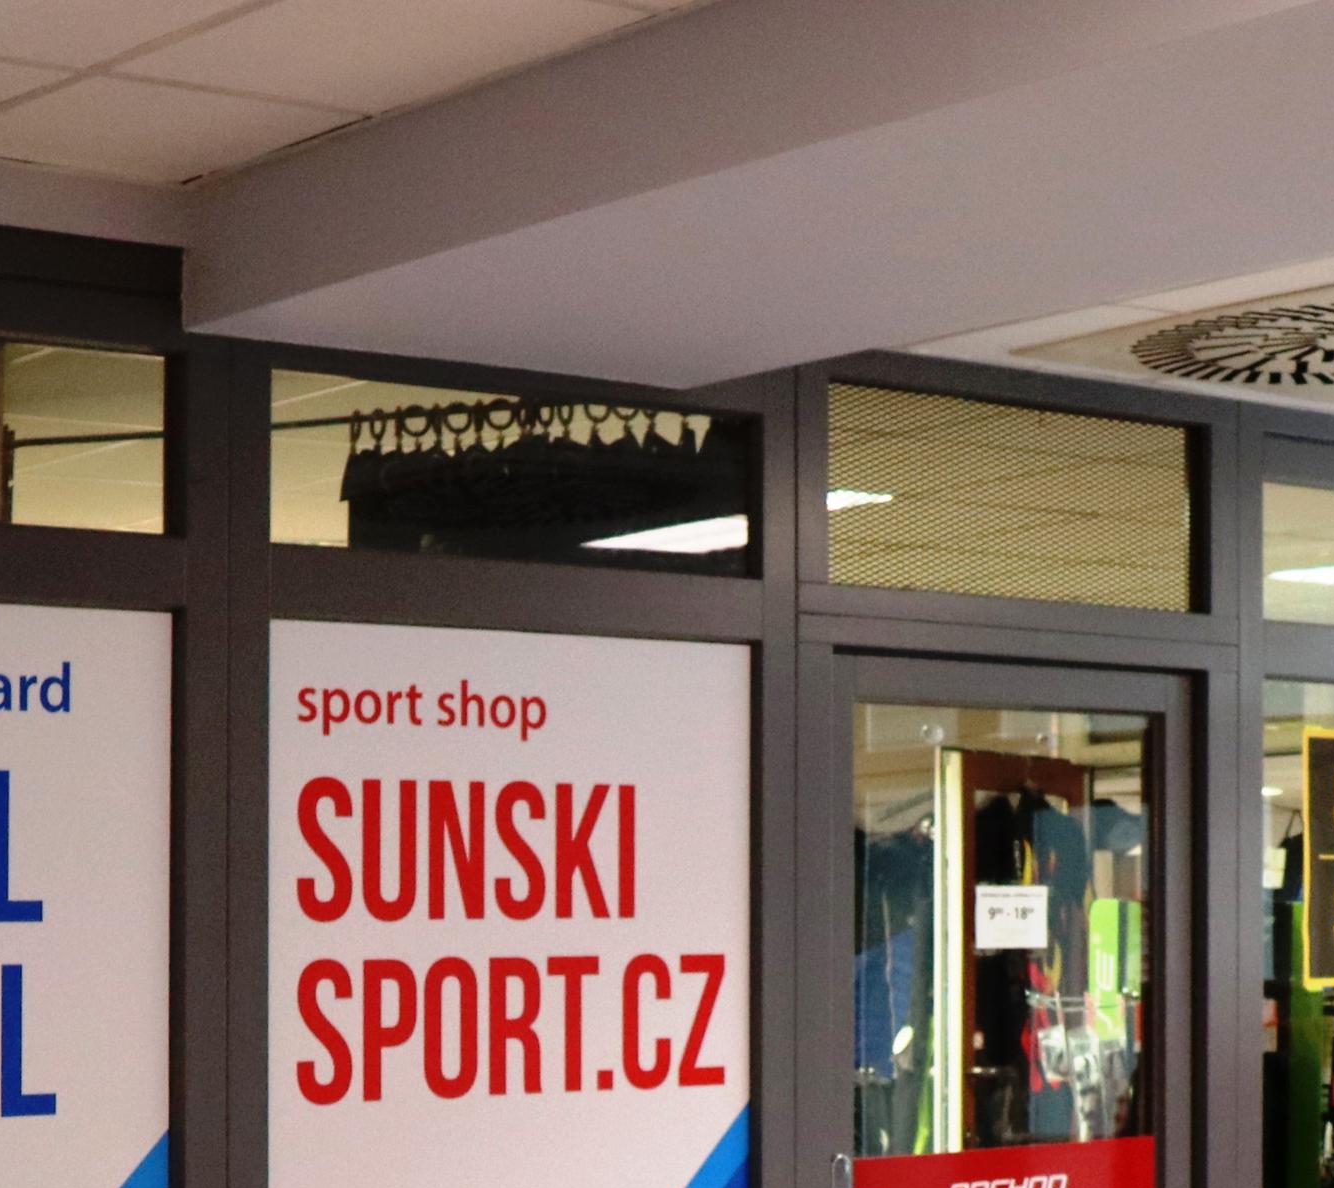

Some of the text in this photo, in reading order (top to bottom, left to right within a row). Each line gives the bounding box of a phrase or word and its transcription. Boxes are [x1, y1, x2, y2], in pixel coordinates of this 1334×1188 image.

[296, 679, 547, 741] sport shop
[296, 776, 636, 922] SUNSKI
[296, 953, 726, 1106] SPORT.CZ
